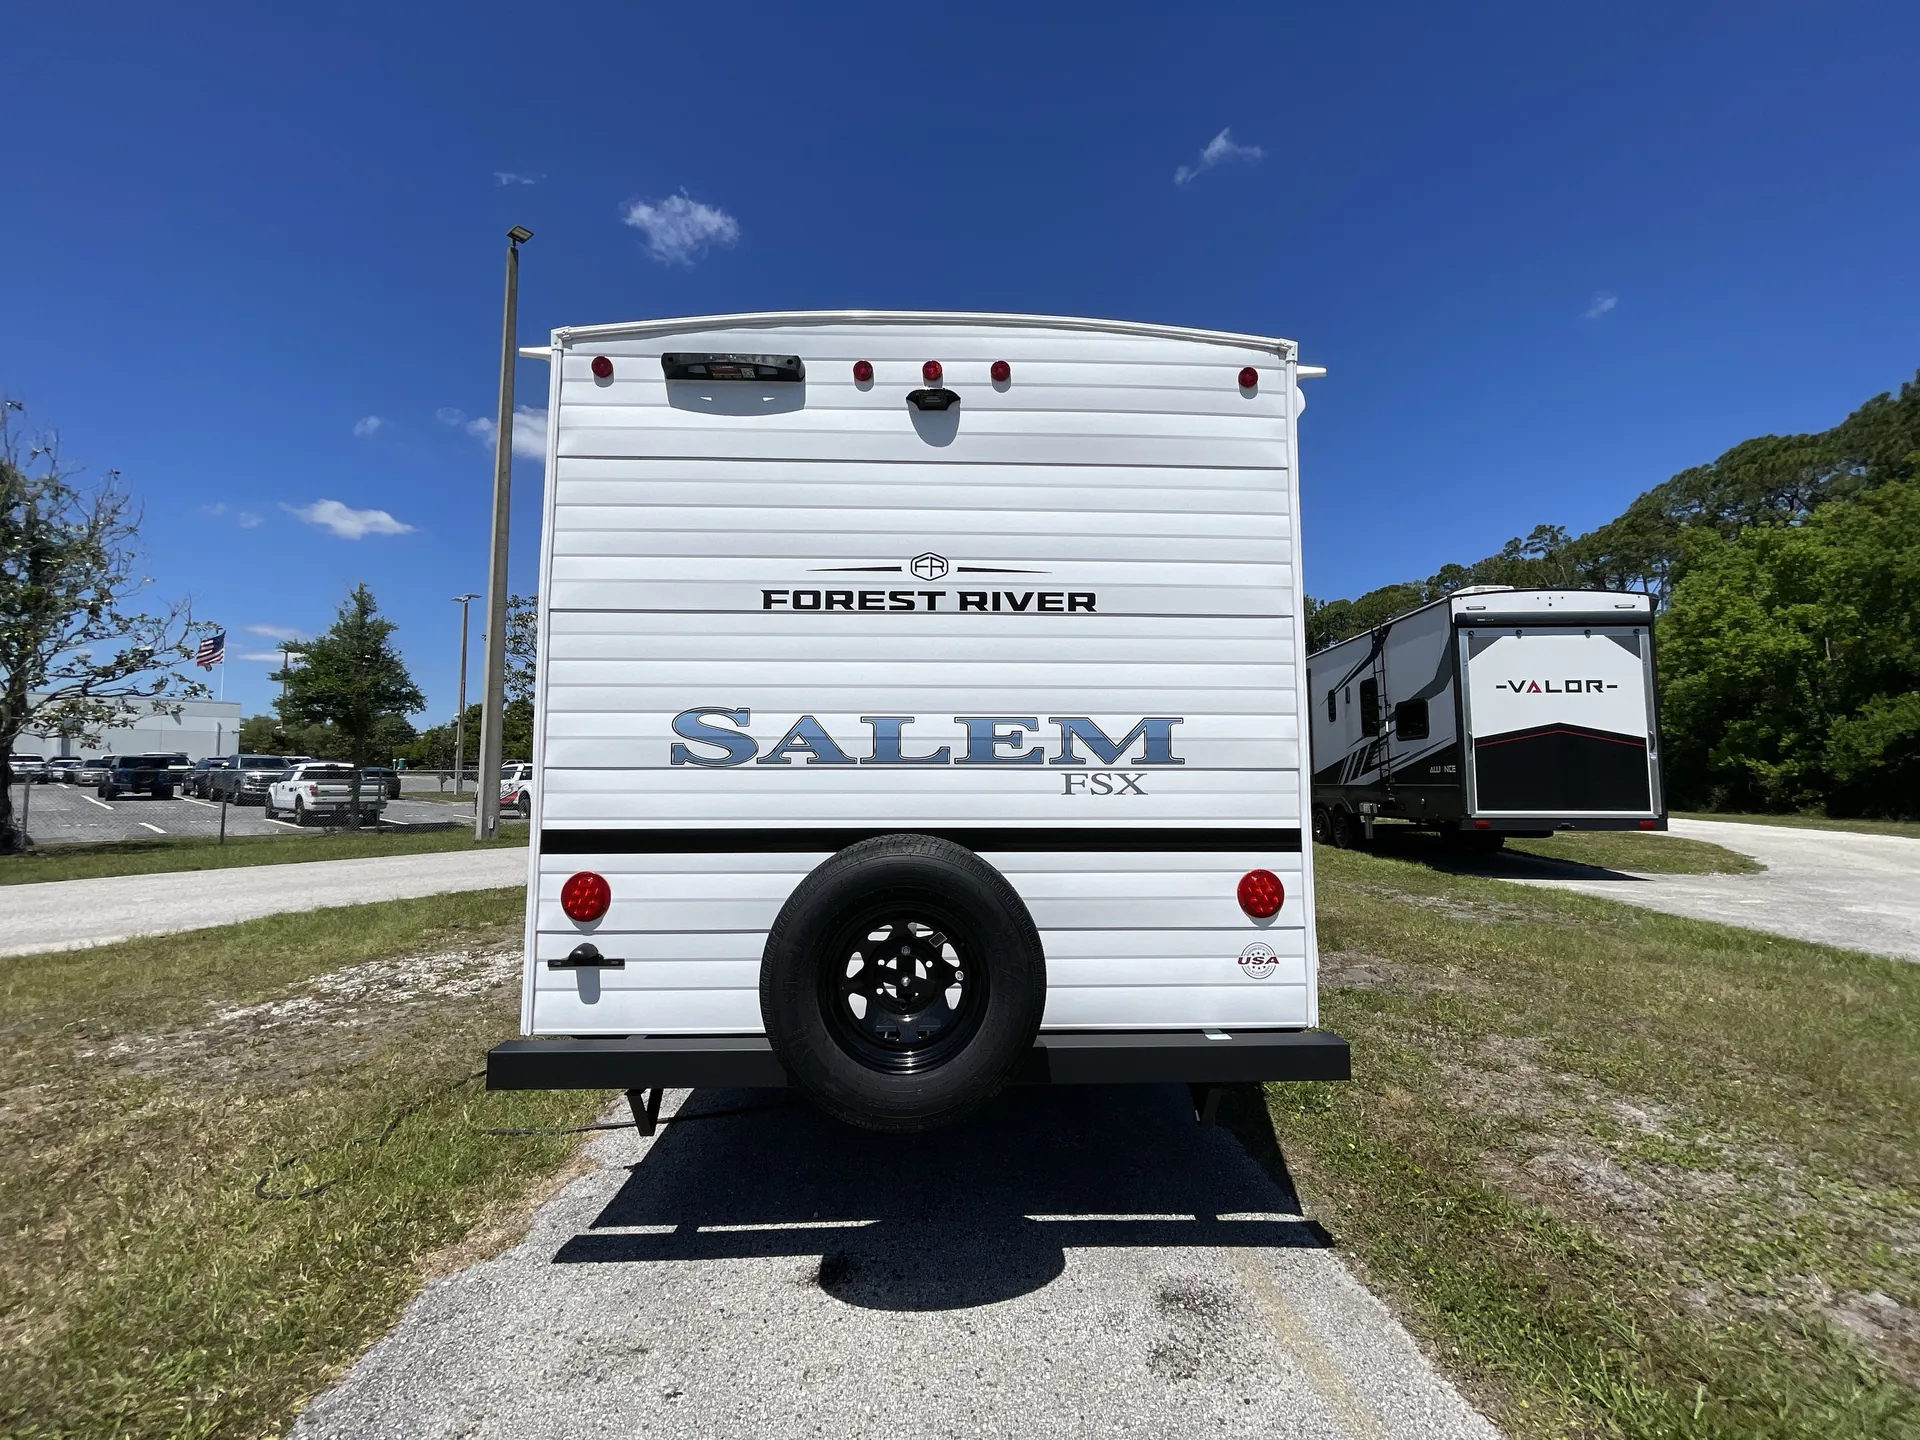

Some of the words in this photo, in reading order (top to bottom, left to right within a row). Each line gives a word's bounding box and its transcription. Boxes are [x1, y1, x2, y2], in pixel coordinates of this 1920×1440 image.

[760, 589, 946, 611] FOREST
[957, 591, 1097, 613] RIVER
[670, 706, 1186, 768] SALEM
[1429, 764, 1457, 774] ALLINCE
[1061, 772, 1149, 796] FSX
[1237, 956, 1280, 965] USA
